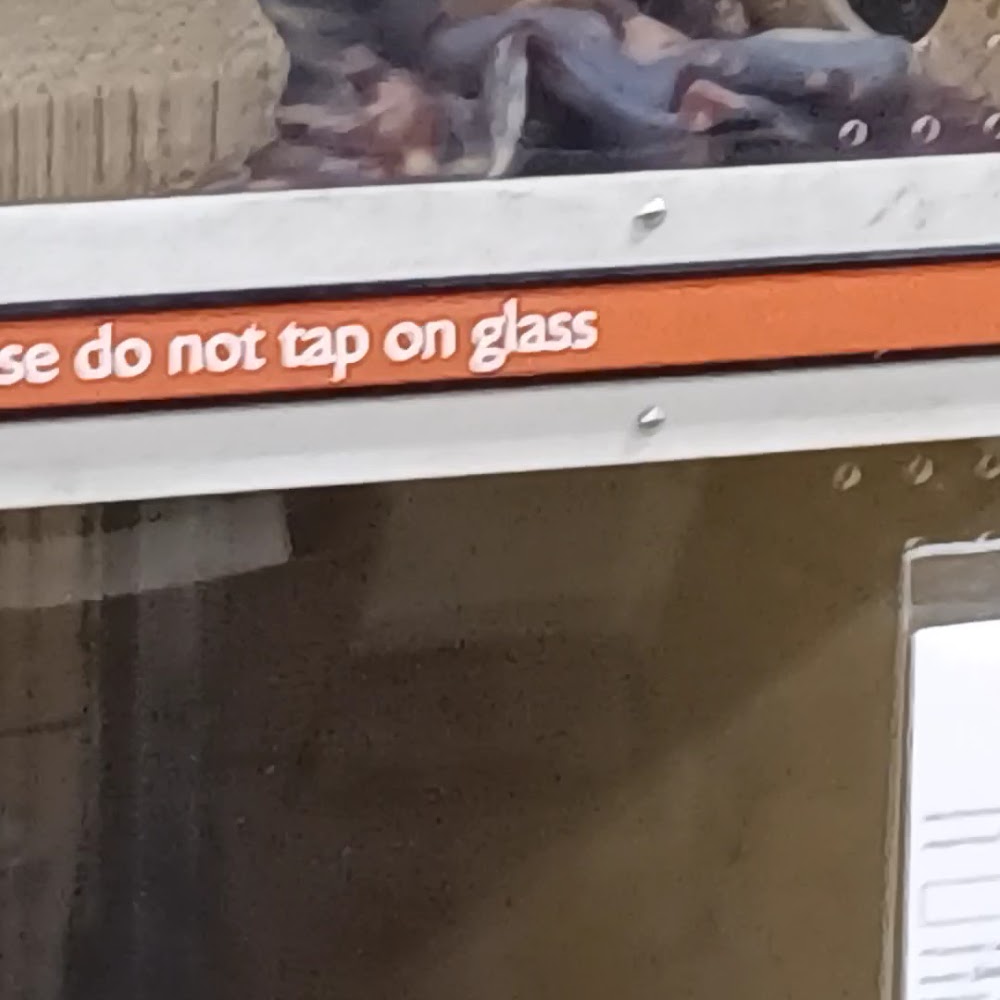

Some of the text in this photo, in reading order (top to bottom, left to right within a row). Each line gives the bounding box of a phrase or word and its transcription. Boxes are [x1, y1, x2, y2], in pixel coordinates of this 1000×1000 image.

[0, 298, 599, 385] se do not tap on glass
